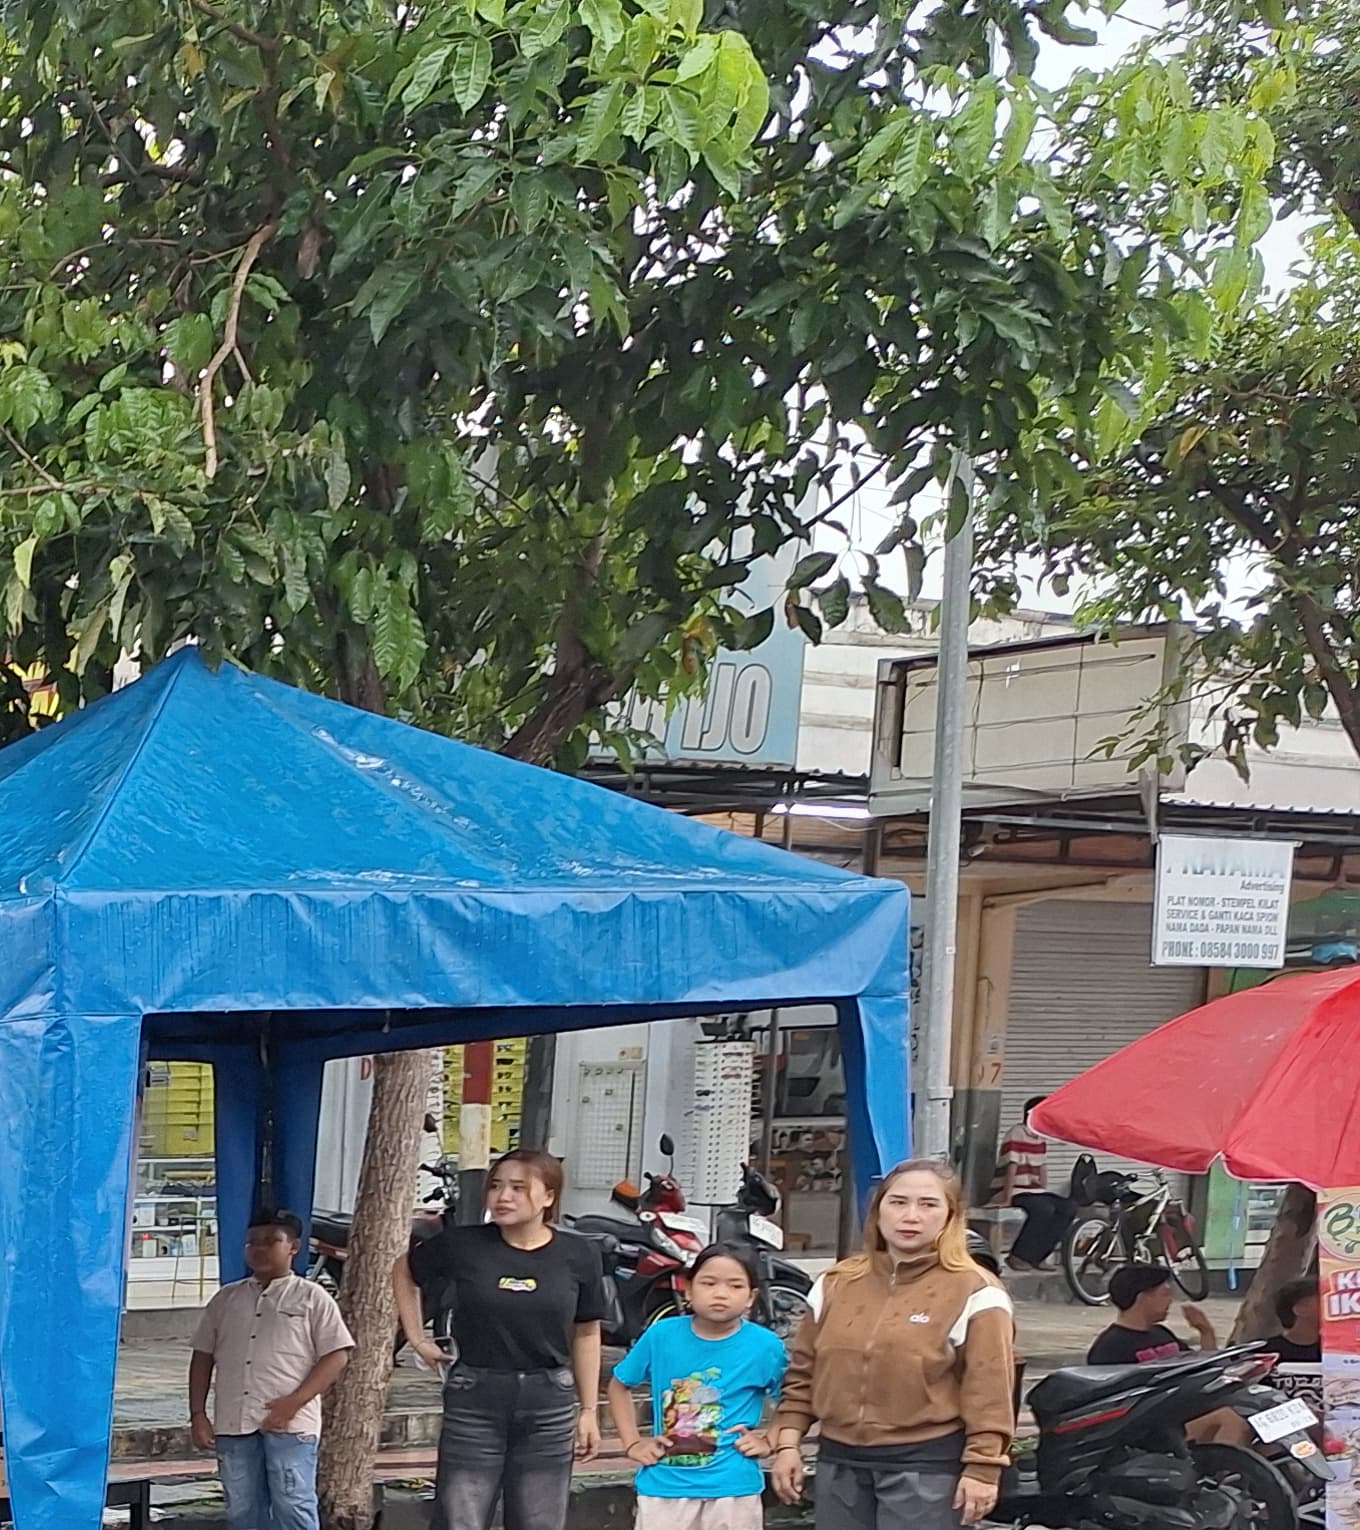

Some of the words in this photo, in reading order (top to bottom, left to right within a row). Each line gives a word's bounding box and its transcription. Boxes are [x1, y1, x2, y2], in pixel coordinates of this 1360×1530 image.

[1167, 896, 1186, 906] PLAT
[1221, 898, 1255, 908] STEMPEL
[1258, 899, 1279, 909] KILAT
[1166, 909, 1198, 920] SERVICE
[1208, 911, 1231, 921] GANTI
[1234, 911, 1254, 922] KACA
[1256, 912, 1279, 922] SPION
[1166, 923, 1187, 932] NAMA
[1190, 923, 1209, 932] DADA
[1216, 924, 1239, 933] PAPAN
[1241, 925, 1262, 934] NAMA
[1261, 943, 1279, 961] 997
